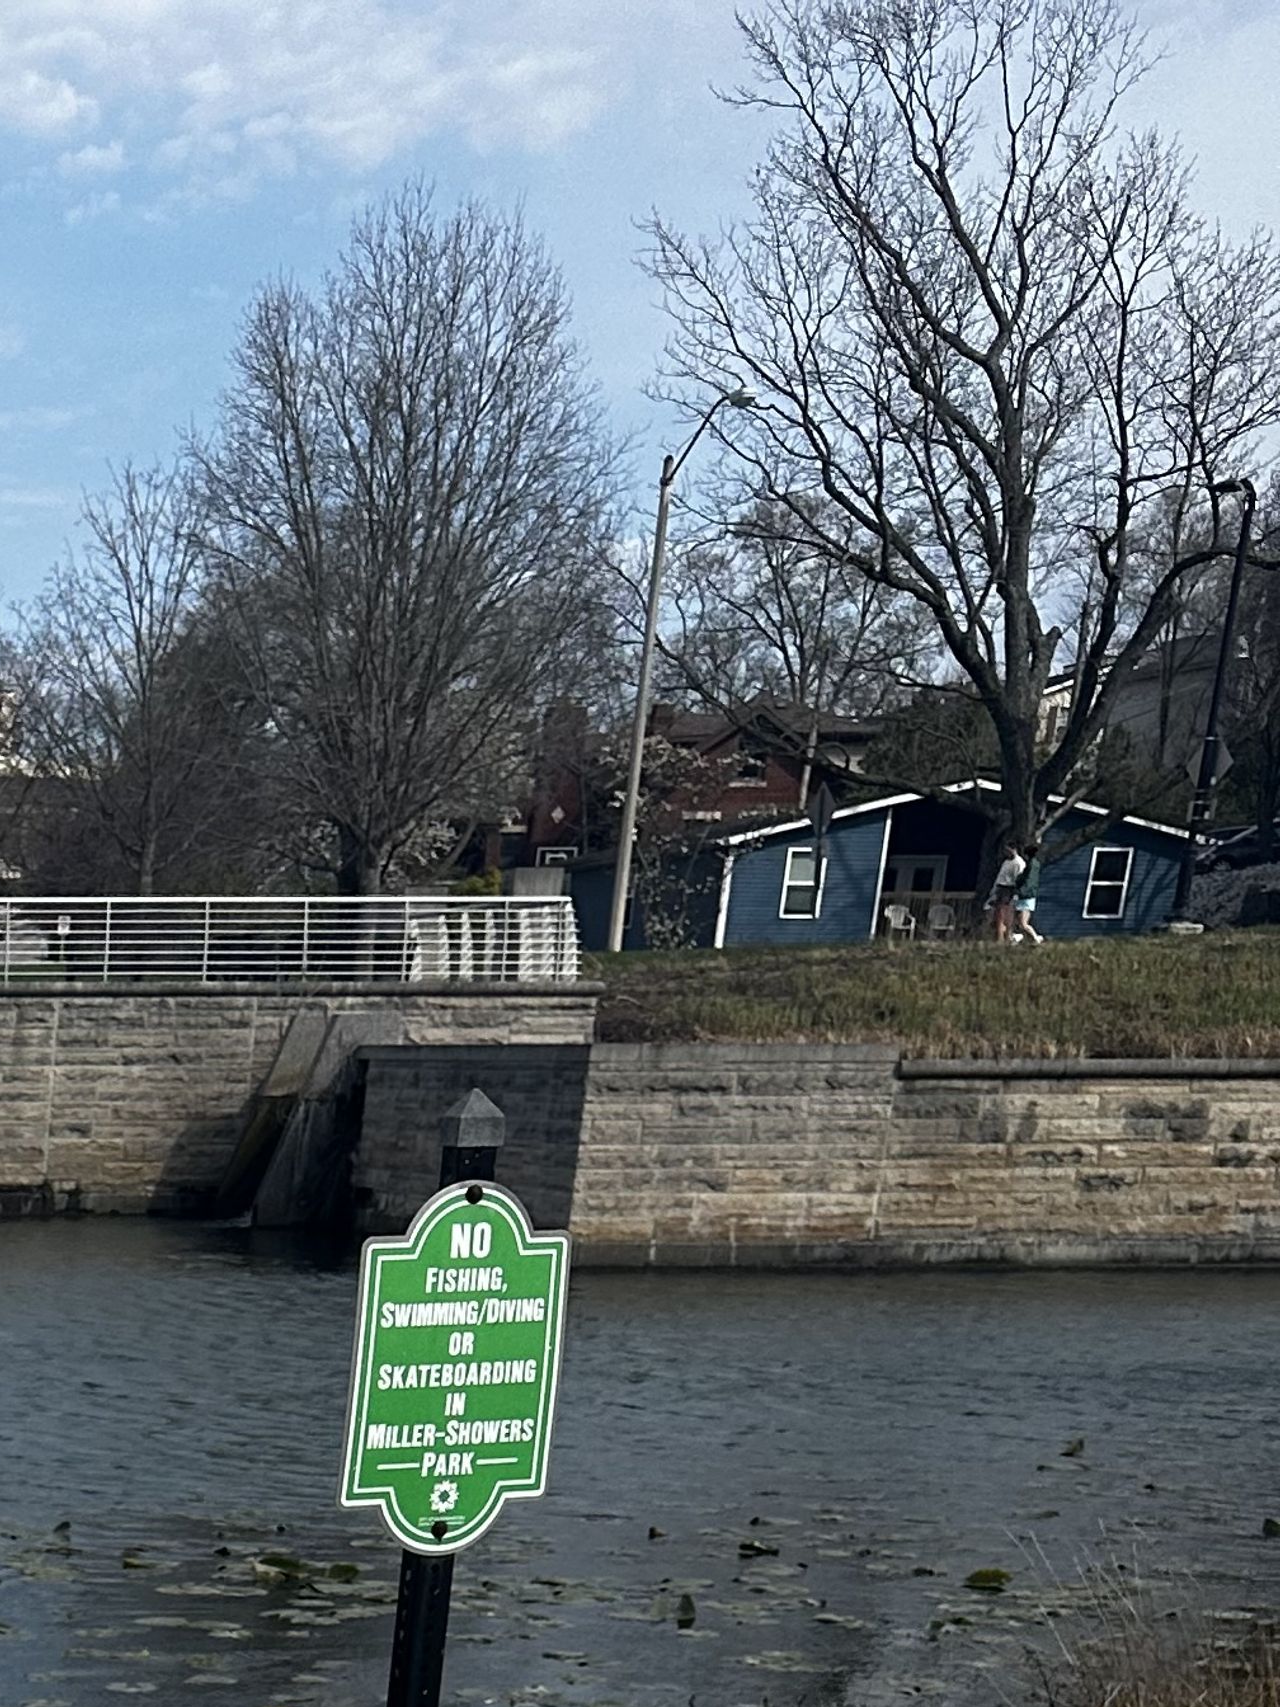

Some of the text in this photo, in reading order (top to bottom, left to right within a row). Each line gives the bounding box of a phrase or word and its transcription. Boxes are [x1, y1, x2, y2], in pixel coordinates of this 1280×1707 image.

[450, 1222, 492, 1259] NO
[425, 1265, 508, 1293] FISHING,
[380, 1298, 544, 1328] SWIMMING/DIVING
[448, 1332, 474, 1356] OR
[377, 1359, 537, 1390] SKATEBOARDING
[444, 1392, 466, 1417] IN
[366, 1418, 534, 1450] MILLER-SHOWERS
[420, 1451, 475, 1477] PARK
